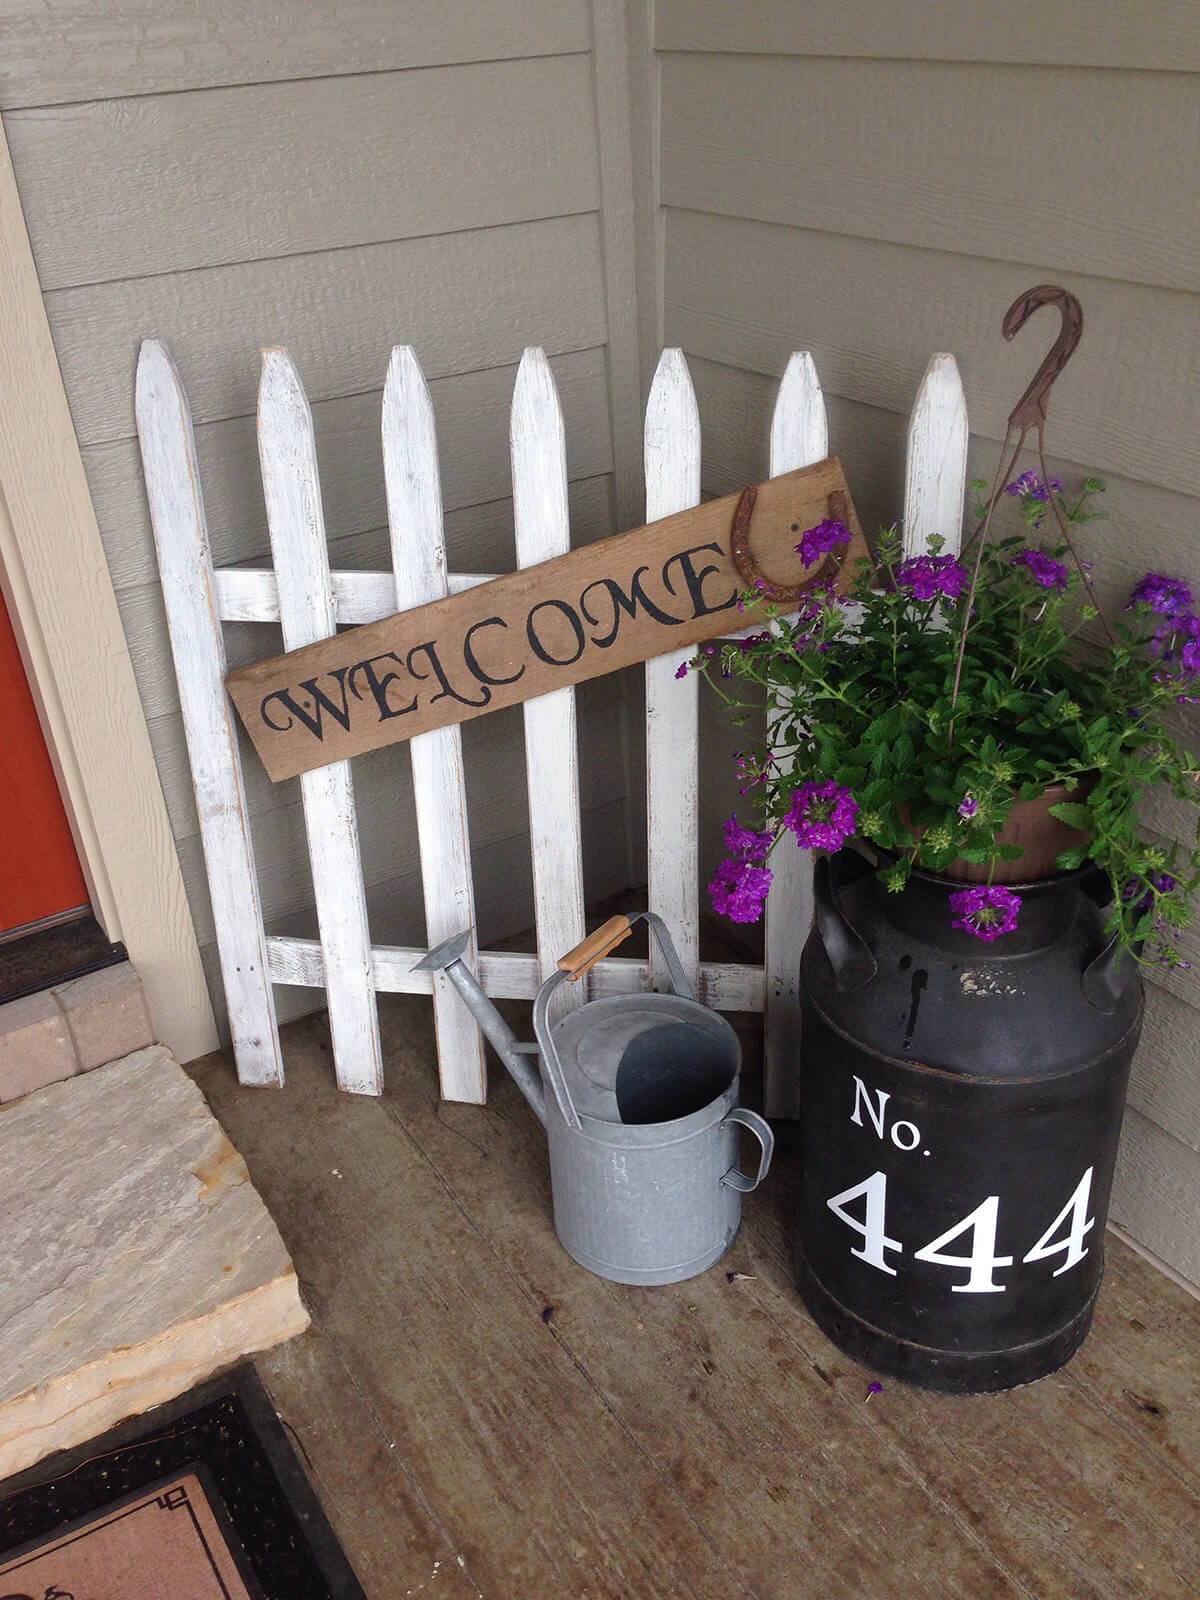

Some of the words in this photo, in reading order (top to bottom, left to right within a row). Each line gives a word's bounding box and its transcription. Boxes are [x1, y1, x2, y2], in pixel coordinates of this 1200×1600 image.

[260, 542, 738, 741] WELCOME
[850, 1075, 931, 1156] No.
[826, 1166, 1095, 1293] 444
